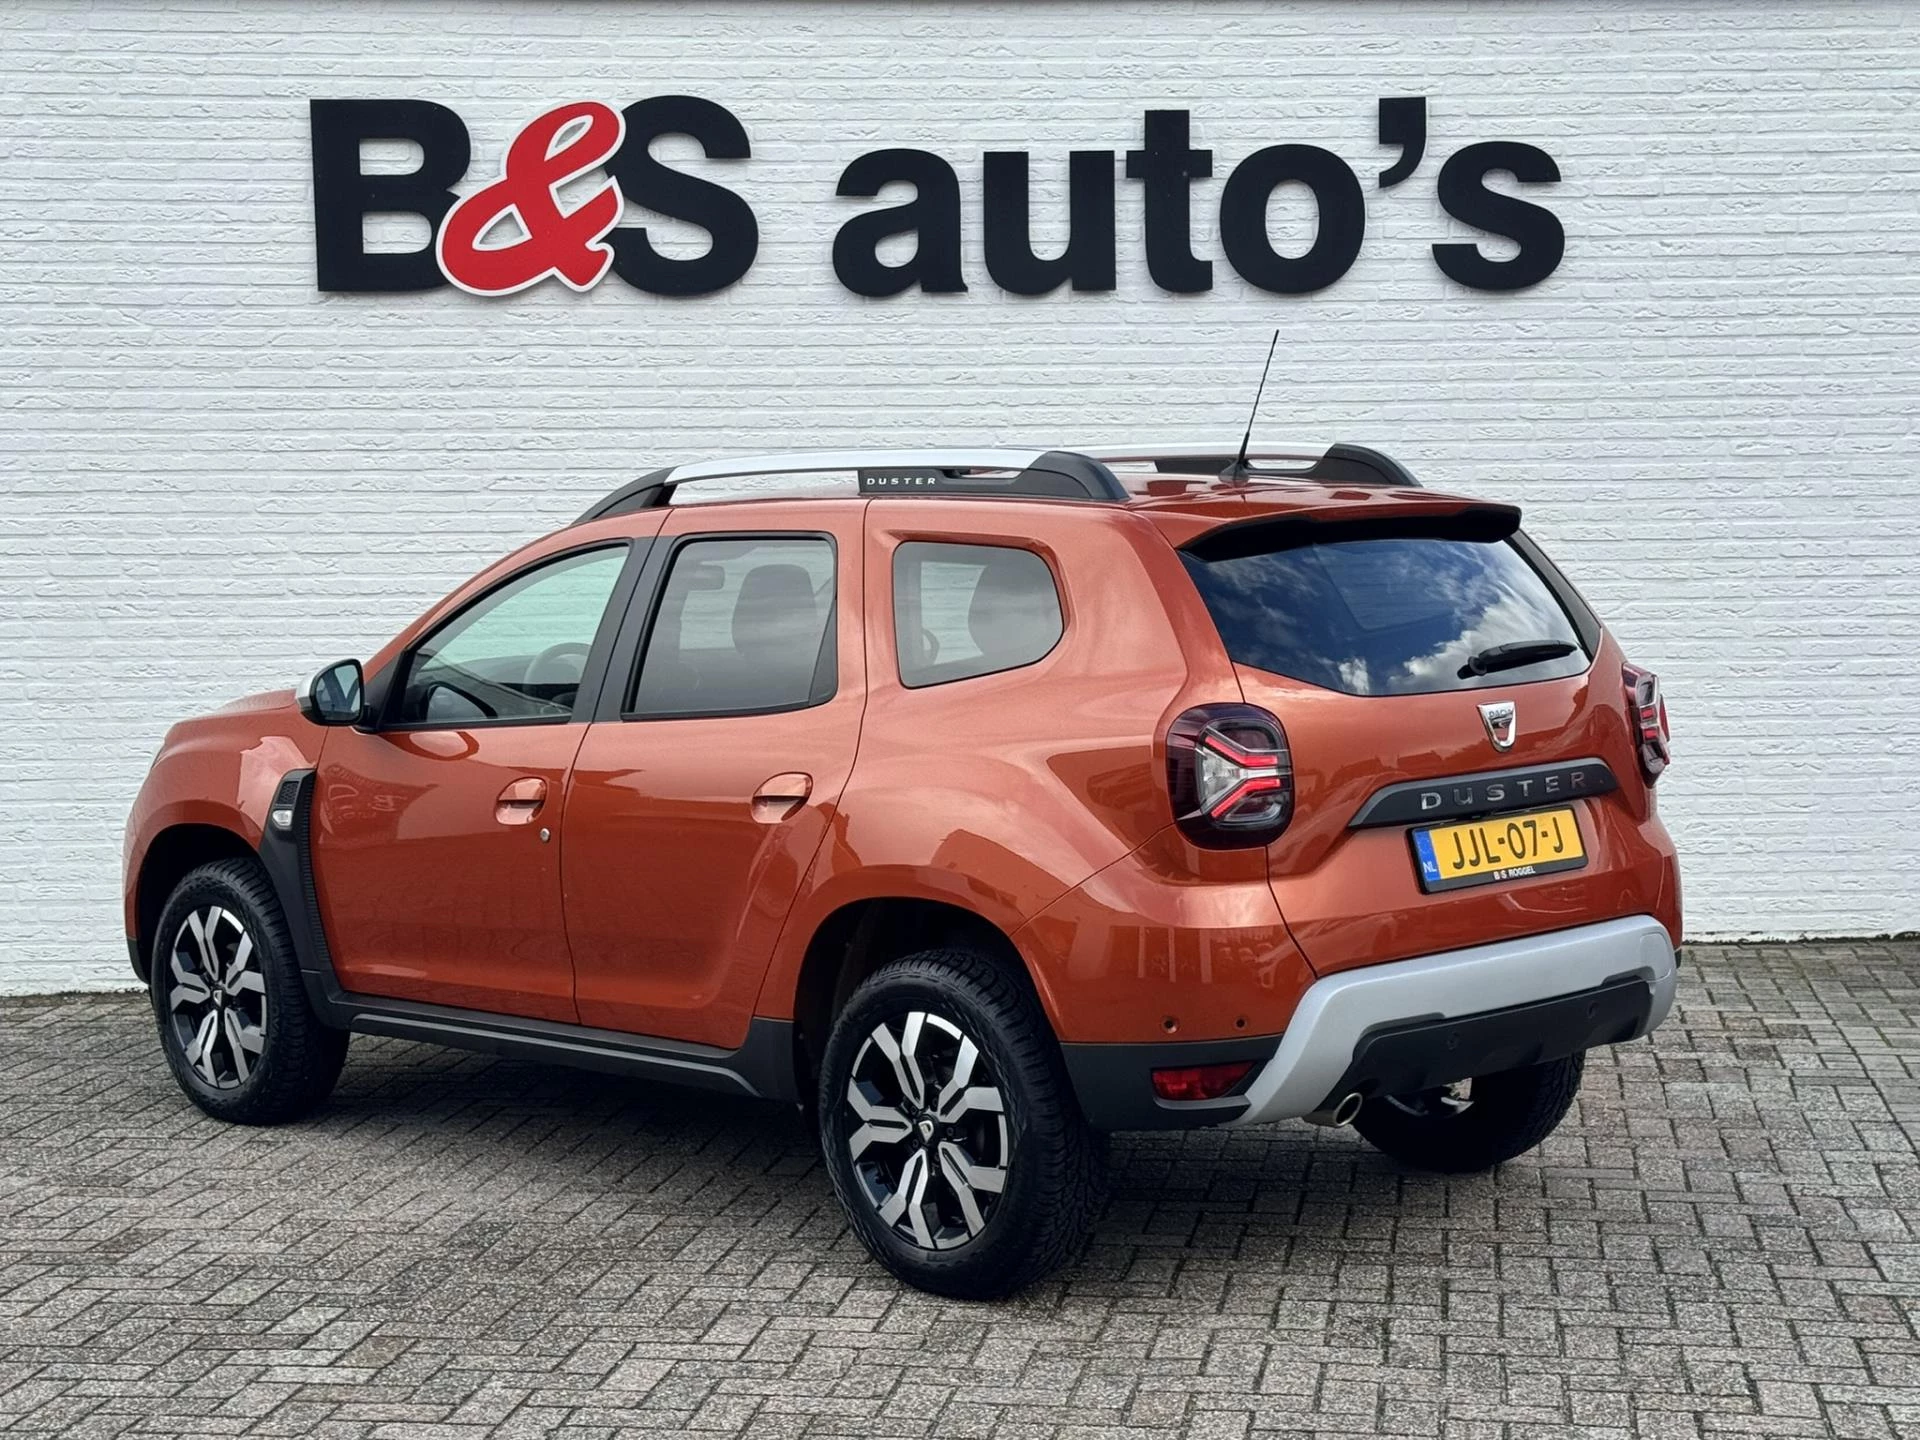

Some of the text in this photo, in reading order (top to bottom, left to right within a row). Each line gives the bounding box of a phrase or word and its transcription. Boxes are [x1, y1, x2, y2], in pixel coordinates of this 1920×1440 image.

[310, 95, 1565, 296] B&S auto's
[867, 476, 937, 486] DUSTER
[1420, 771, 1586, 811] DUSTER
[1452, 816, 1564, 870] JJL-07-J
[1423, 862, 1437, 874] NL
